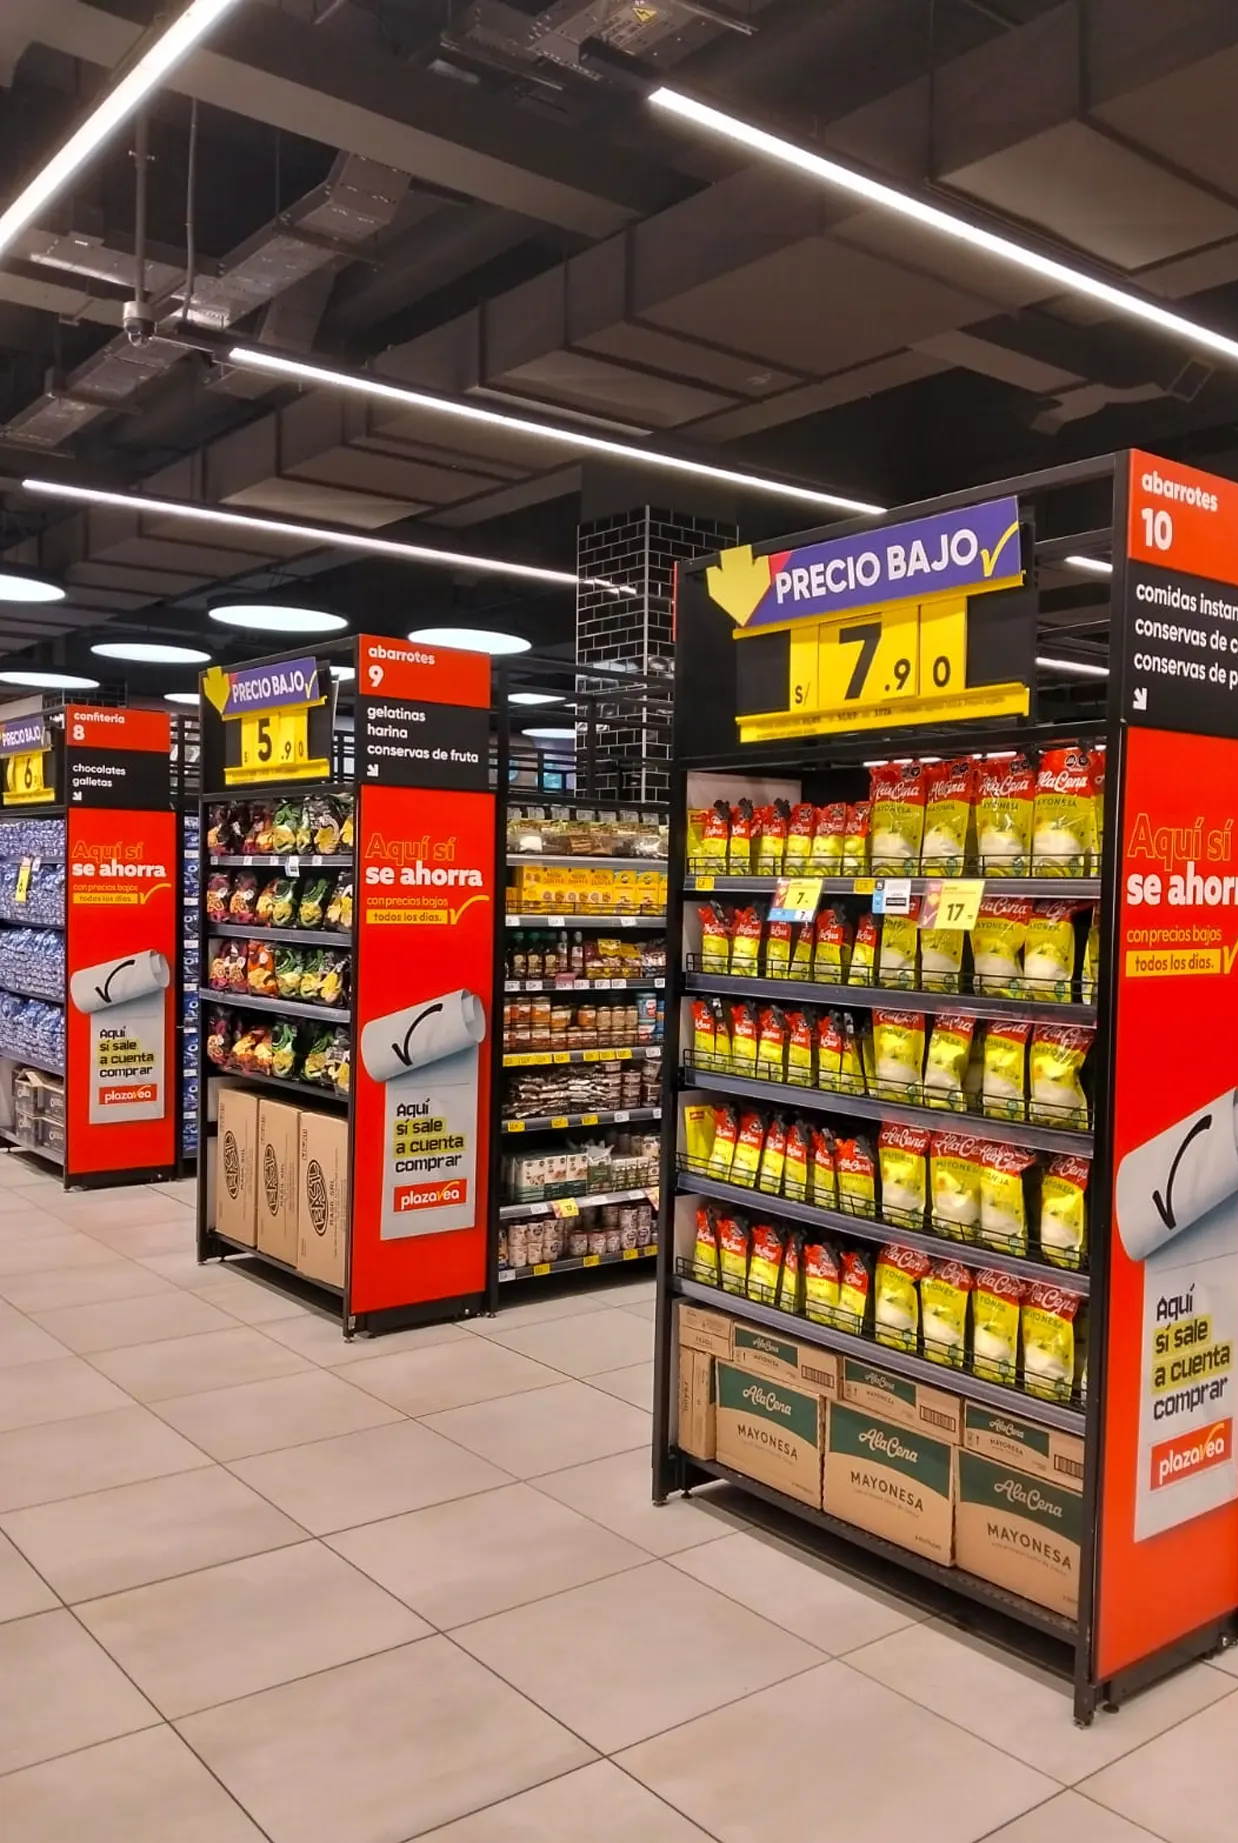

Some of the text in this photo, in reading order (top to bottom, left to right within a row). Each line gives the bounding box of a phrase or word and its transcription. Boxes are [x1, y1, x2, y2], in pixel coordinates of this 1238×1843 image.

[1142, 471, 1218, 512] abarrotes
[1142, 507, 1173, 550] 10
[775, 529, 978, 604] PRECIO BAJO
[1136, 583, 1197, 611] comidas
[1135, 618, 1207, 647] conservas
[1210, 630, 1227, 651] de
[368, 645, 435, 665] abarrotes
[1134, 652, 1205, 680] conservas
[1209, 662, 1226, 683] de
[233, 670, 304, 703] PRECIO BAJO
[368, 665, 384, 688] 9
[368, 706, 425, 722] gelatinas
[73, 725, 85, 740] 8
[368, 723, 407, 739] harina
[367, 743, 478, 763] conservas de fruta
[72, 763, 126, 775] chocolates
[72, 776, 112, 787] galletas
[72, 840, 123, 864] Aquí
[365, 832, 457, 866] Aquí sí
[1127, 813, 1233, 872] Aquí sí
[72, 858, 166, 877] se ahorra
[366, 860, 483, 886] se ahorra
[1127, 873, 1162, 906] se
[1127, 924, 1222, 946] con precios bajos
[1135, 956, 1167, 971] todos
[1171, 955, 1185, 970] los
[100, 1026, 126, 1039] Aquí
[100, 1040, 136, 1051] sí sale
[100, 1053, 154, 1064] a cuenta
[99, 1066, 153, 1078] comprar
[396, 1098, 430, 1117] Aquí
[396, 1119, 442, 1135] sí sale
[396, 1135, 464, 1153] a cuenta
[395, 1154, 462, 1173] comprar
[1157, 1283, 1195, 1322] Aquí
[1156, 1319, 1208, 1353] sí sale
[1155, 1345, 1230, 1387] a cuenta
[743, 1385, 792, 1416] AlaCena
[1154, 1377, 1228, 1420] comprar
[738, 1424, 799, 1461] MAYONESA
[859, 1428, 919, 1464] AlaCena
[850, 1471, 924, 1512] MAYONESA
[994, 1479, 1063, 1518] AlaCena
[987, 1522, 1072, 1571] MAYONESA
